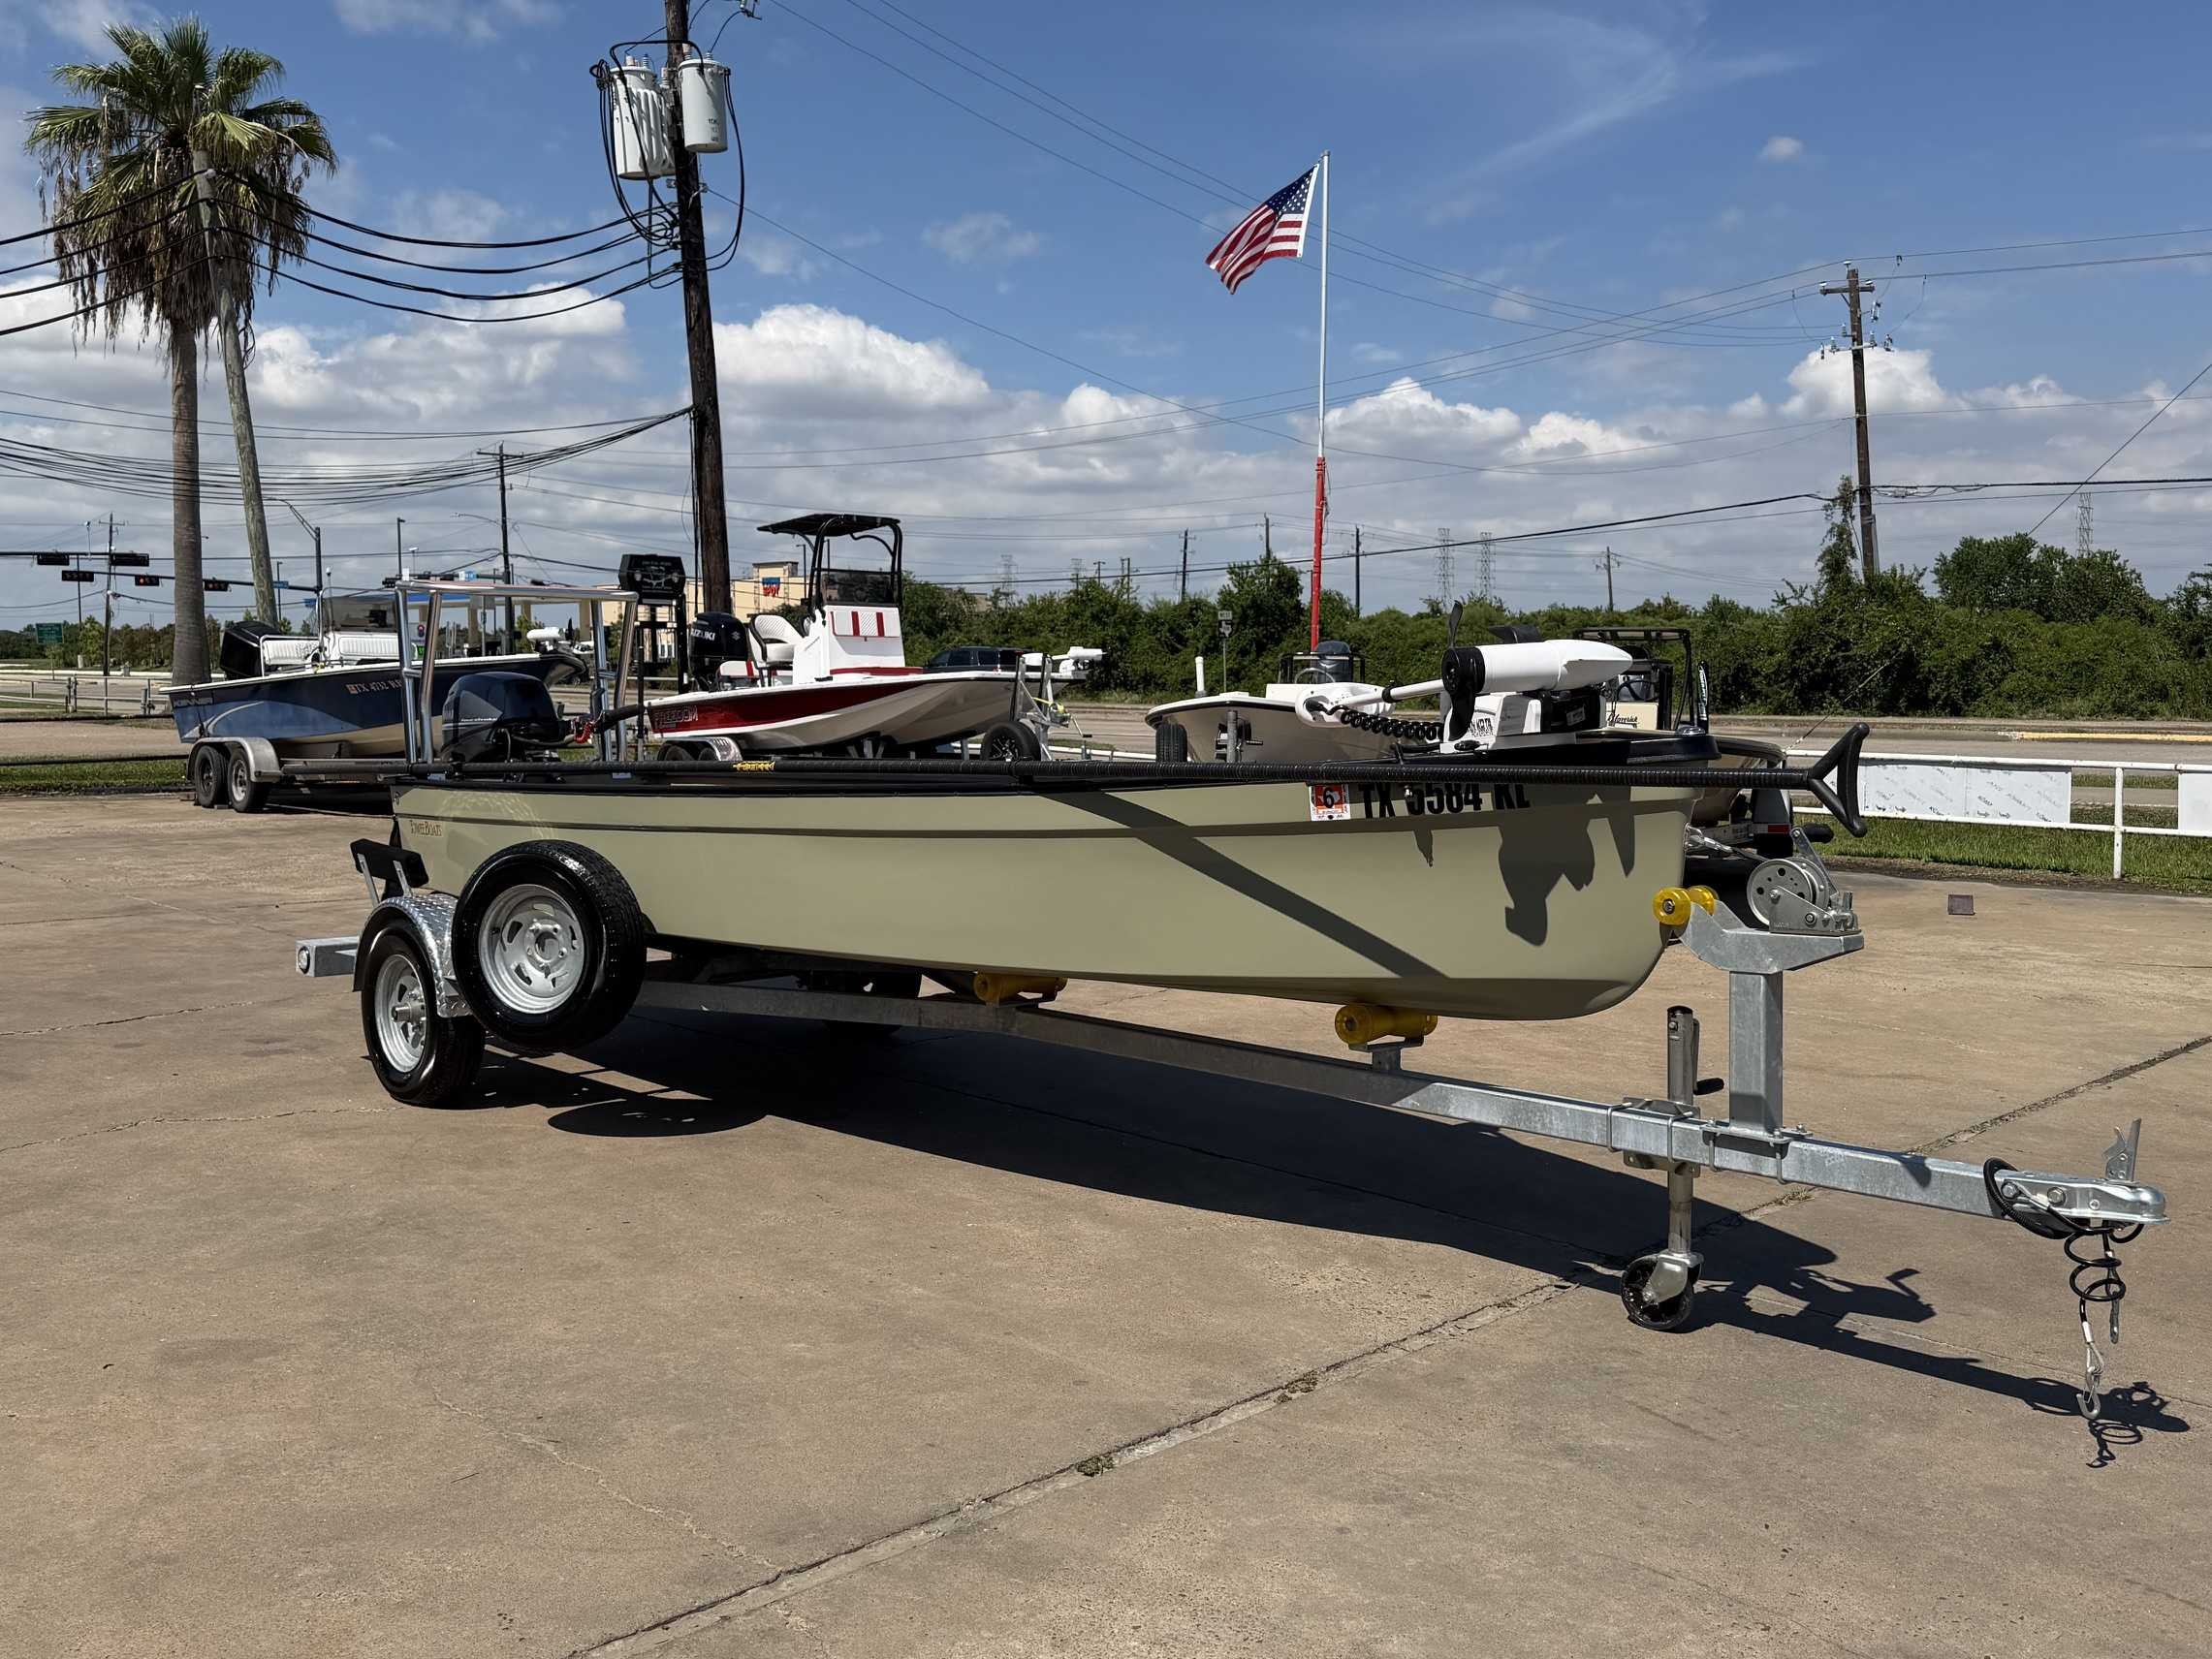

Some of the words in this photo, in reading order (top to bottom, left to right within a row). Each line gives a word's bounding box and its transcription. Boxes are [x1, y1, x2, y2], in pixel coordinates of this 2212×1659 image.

[1323, 787, 1335, 809] 6
[1358, 783, 1396, 819] TX
[1494, 783, 1531, 810] KL
